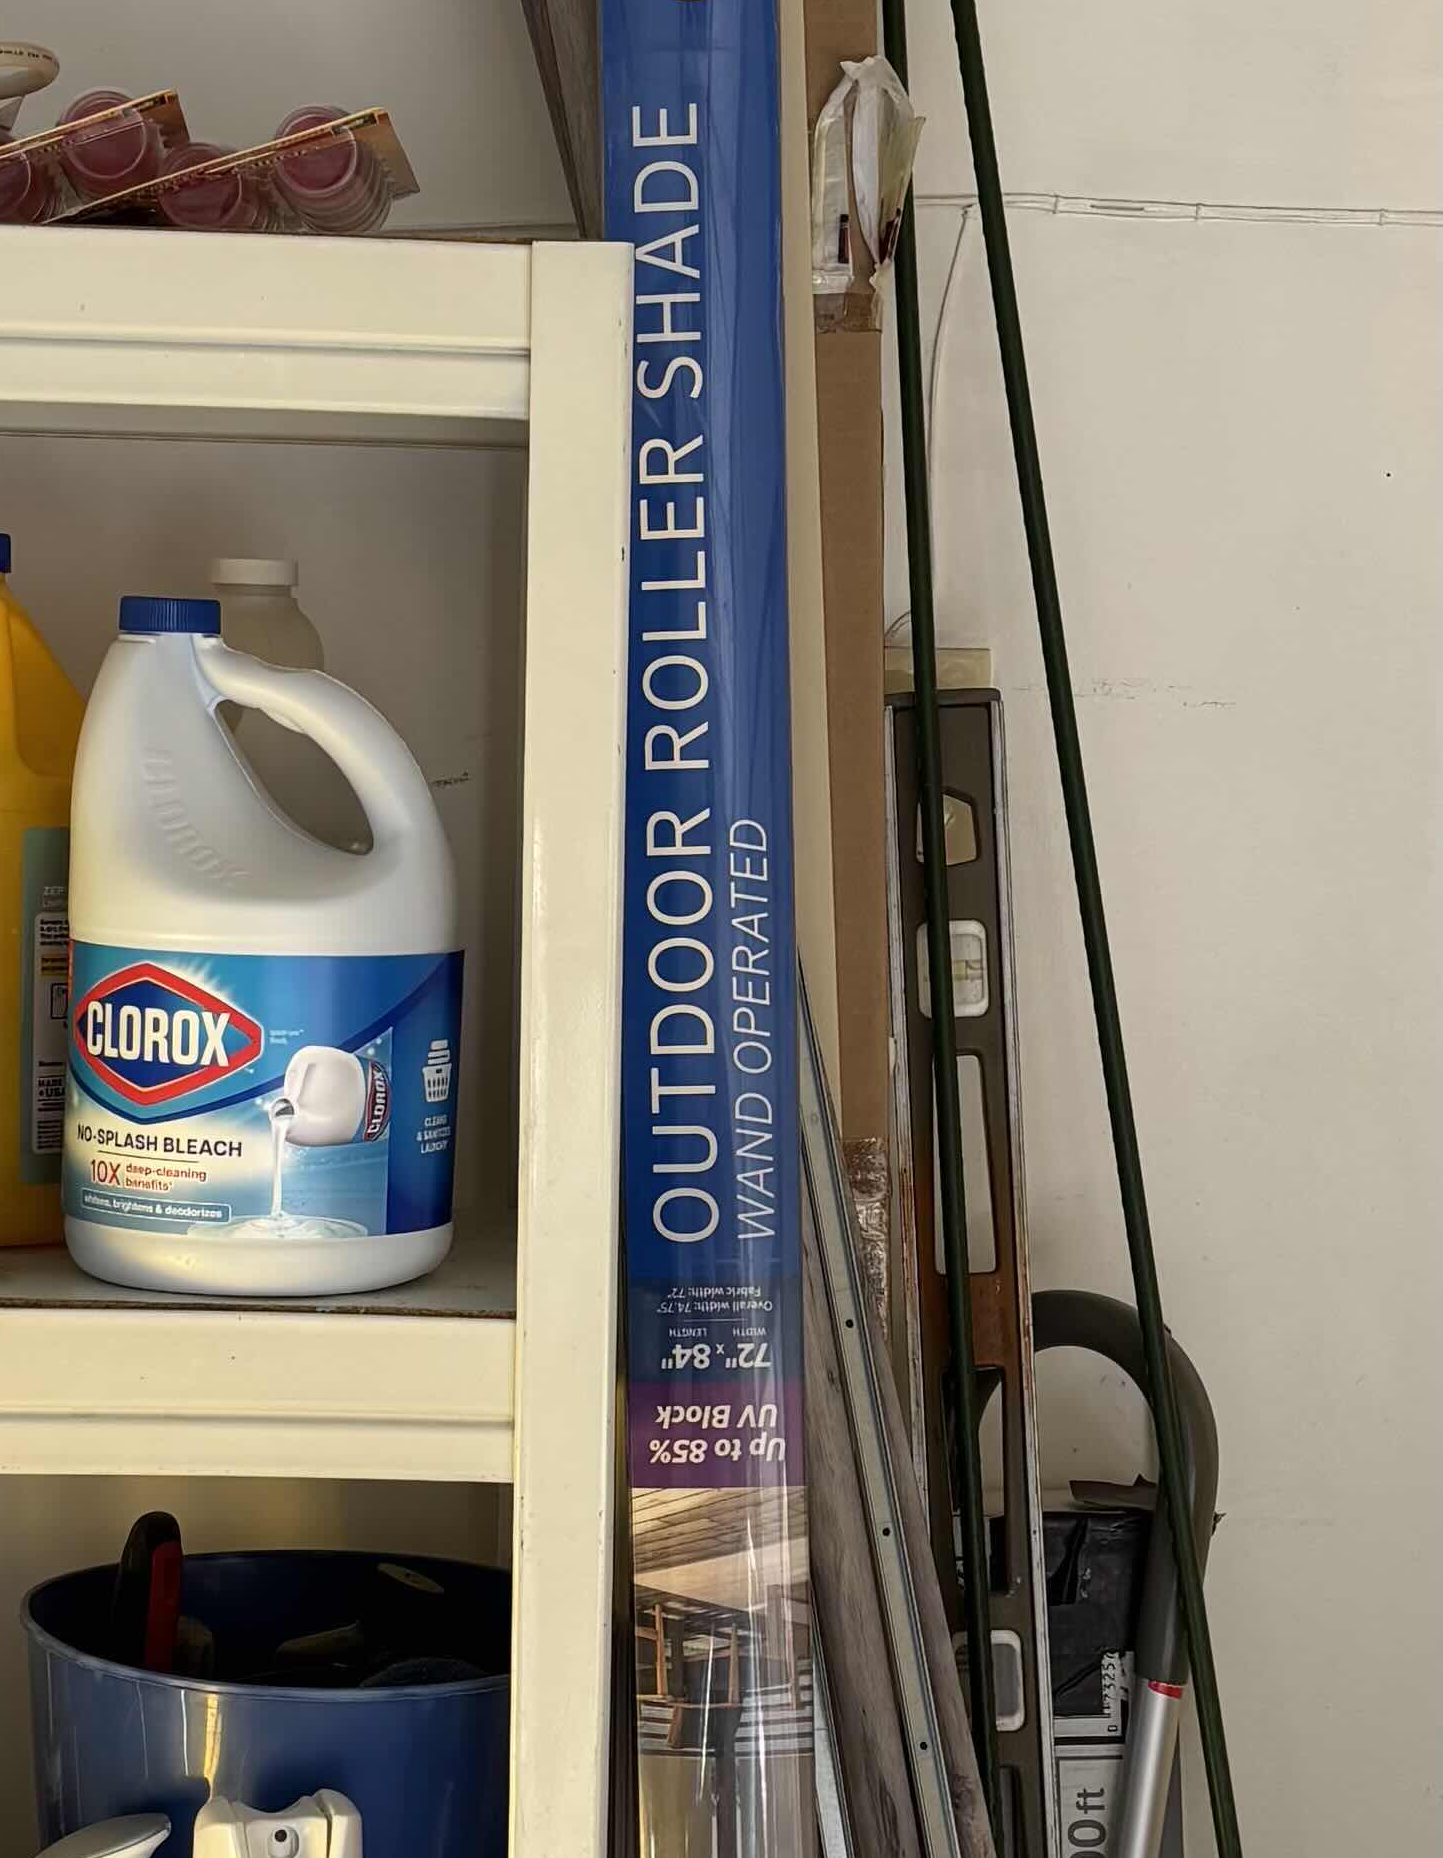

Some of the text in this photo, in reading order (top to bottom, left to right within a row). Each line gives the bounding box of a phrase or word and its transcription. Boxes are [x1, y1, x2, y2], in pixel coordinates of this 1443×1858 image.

[631, 102, 721, 1244] OUTDOOR ROLLER SHADE
[86, 999, 232, 1068] CLOROX
[728, 817, 779, 1242] WAND OPERATED
[77, 1123, 243, 1157] NO-SPLASH BLEACH
[90, 1158, 122, 1186] 10X
[732, 1299, 773, 1313] Overall
[668, 1326, 766, 1338] WIDTH LENGTH
[660, 1342, 772, 1370] 72" 84"
[653, 1403, 778, 1430] UV Block
[648, 1431, 787, 1464] Up to 85%
[1076, 1787, 1106, 1815] ft
